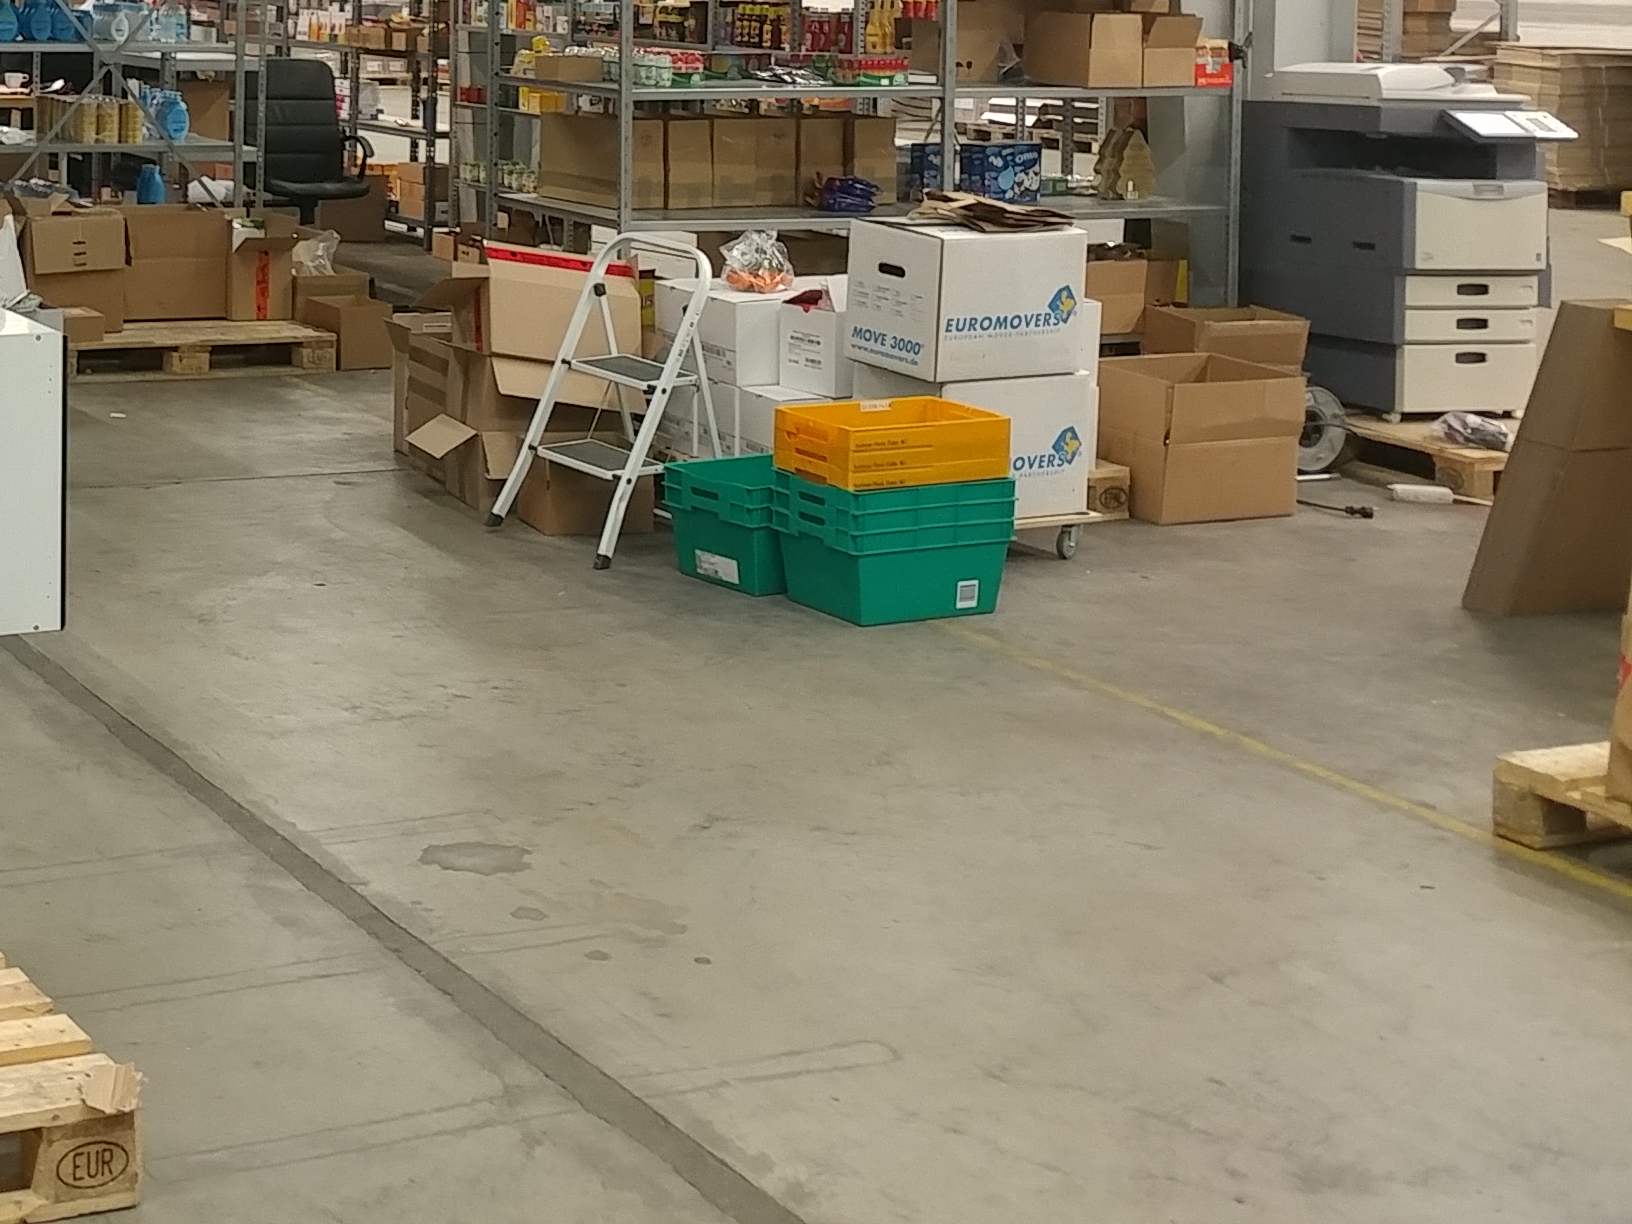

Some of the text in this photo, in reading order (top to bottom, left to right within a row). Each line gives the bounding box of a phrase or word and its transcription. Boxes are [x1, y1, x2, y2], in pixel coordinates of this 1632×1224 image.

[944, 312, 1061, 333] EUROMOVERS
[852, 325, 922, 356] MOVE 3000
[851, 343, 919, 367] www.euromovers.de
[1012, 453, 1065, 472] OVERS
[72, 1147, 114, 1182] EUR
